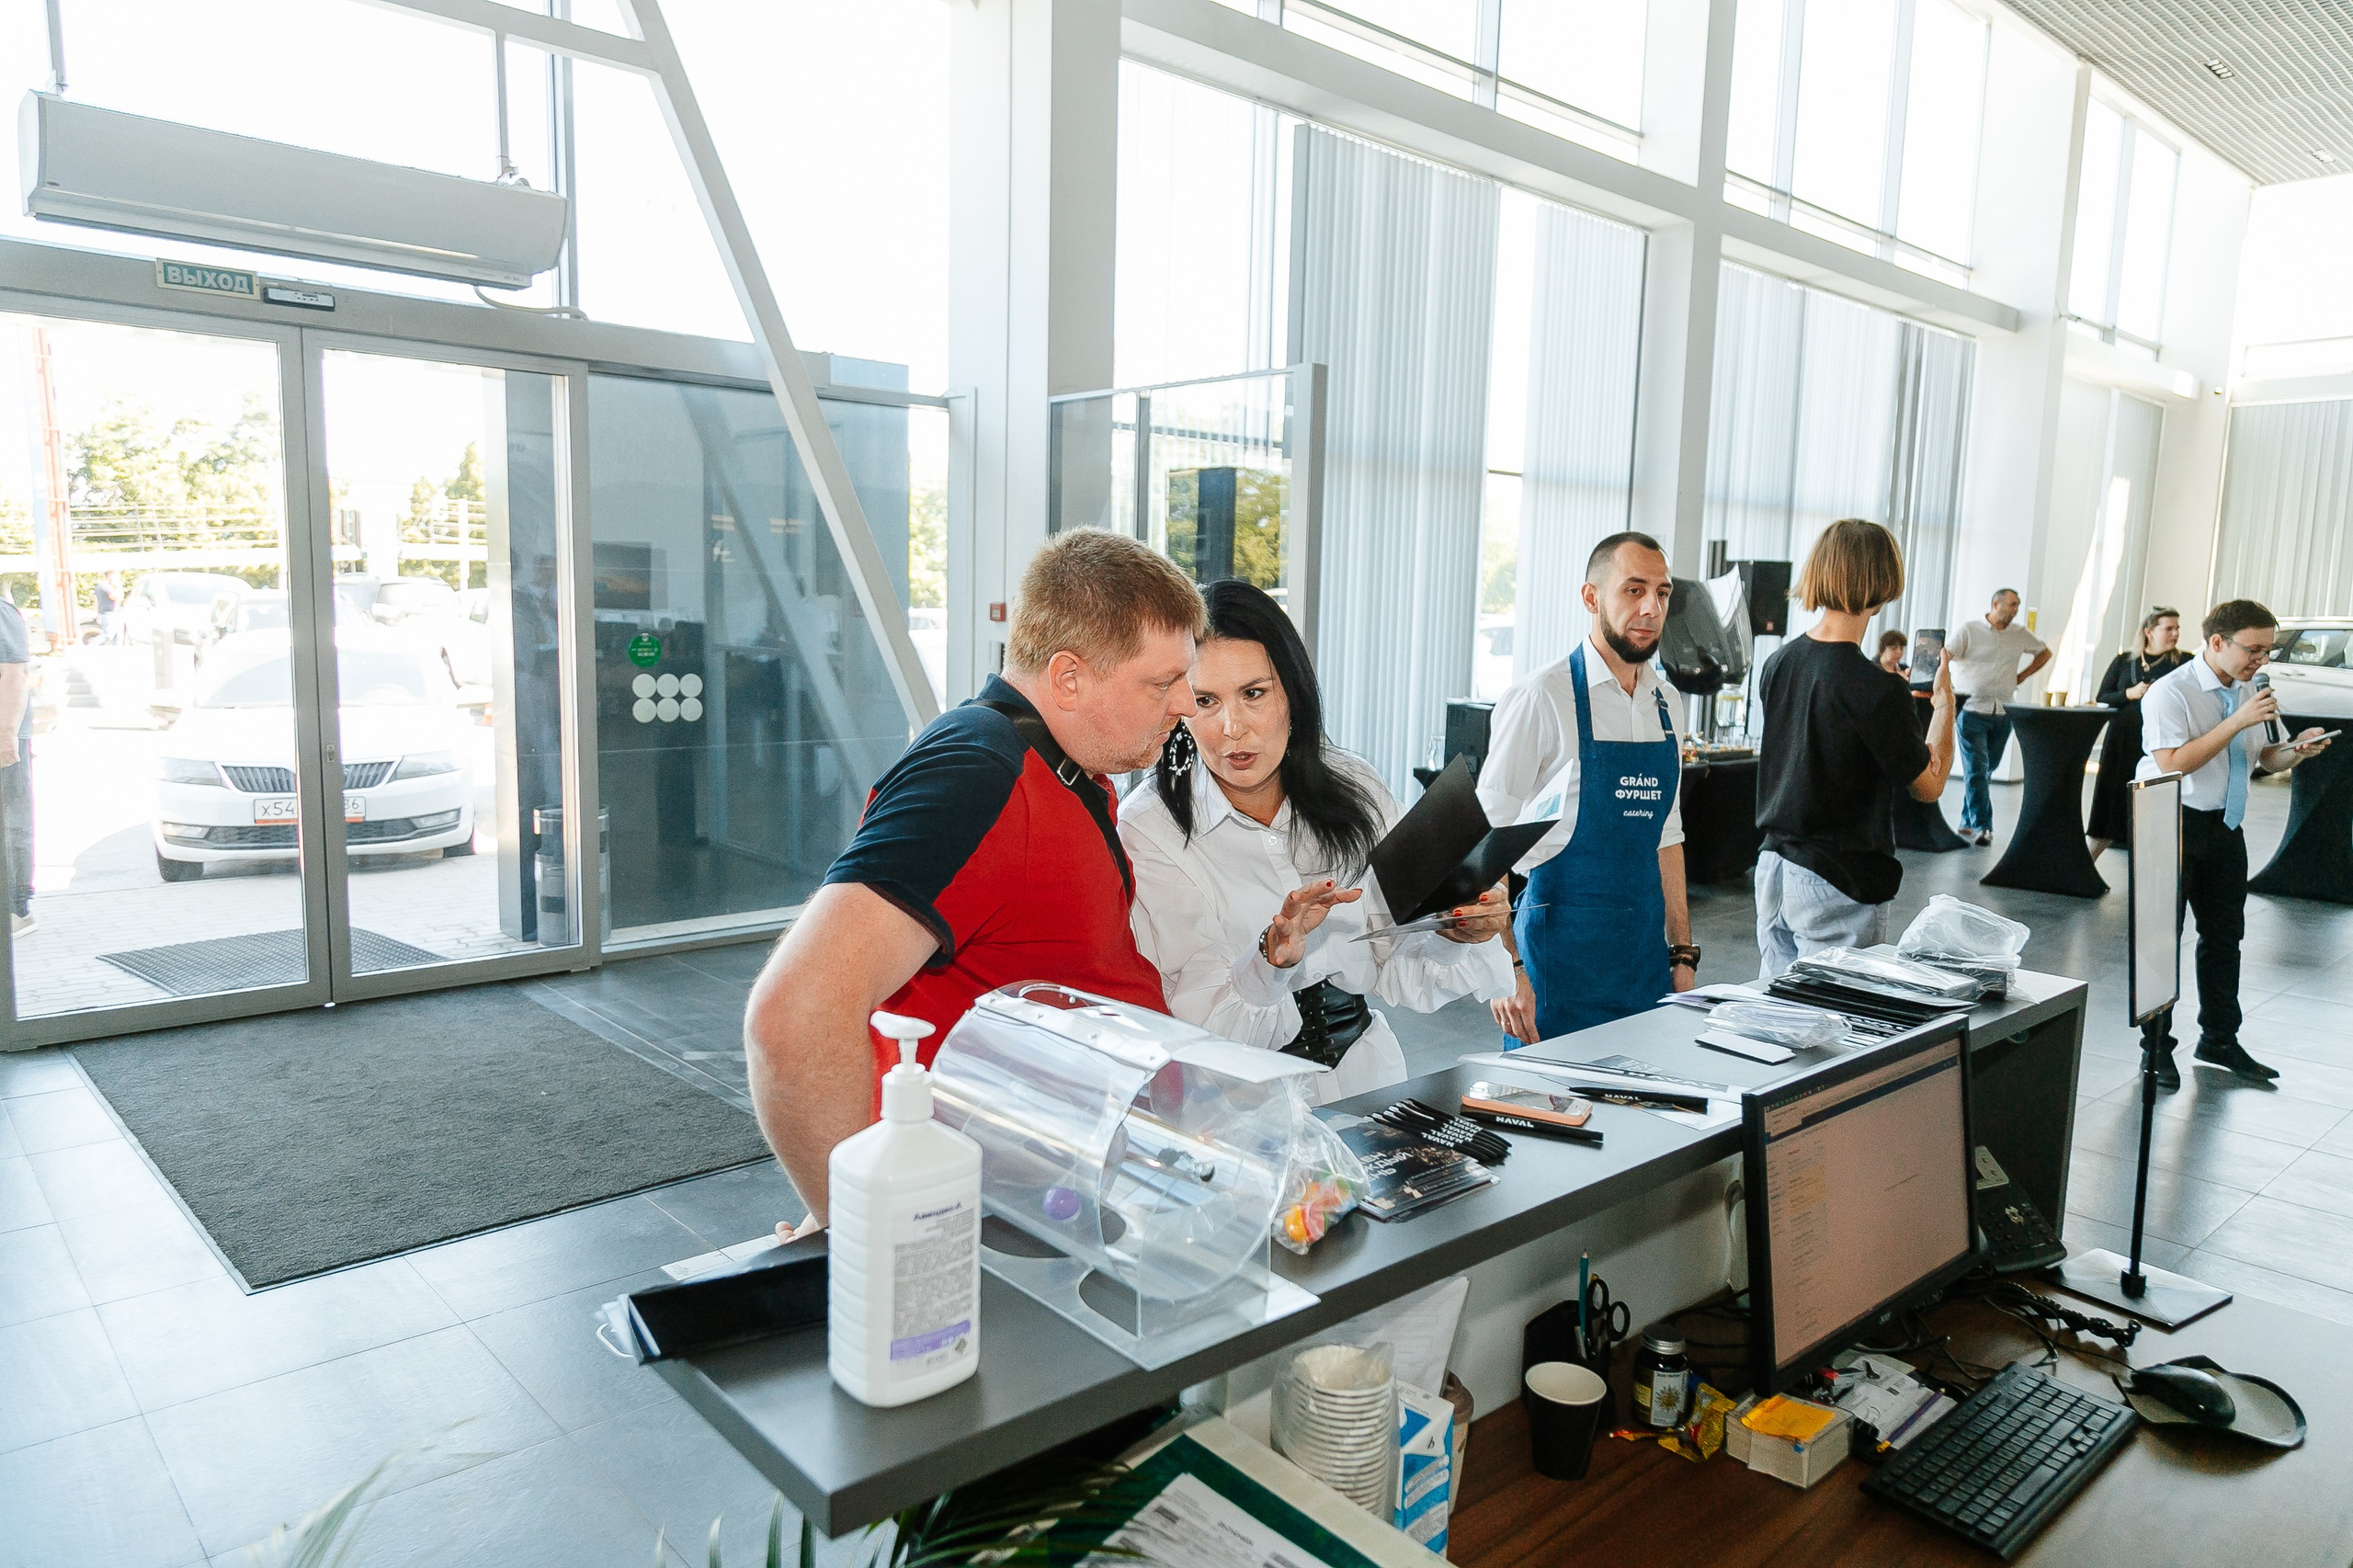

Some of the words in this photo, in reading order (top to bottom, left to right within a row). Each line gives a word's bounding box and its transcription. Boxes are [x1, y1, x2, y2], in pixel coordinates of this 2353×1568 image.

[166, 266, 250, 293] ВЫХОД
[1615, 789, 1662, 801] ФУРШЕТ
[1622, 809, 1654, 820] catering
